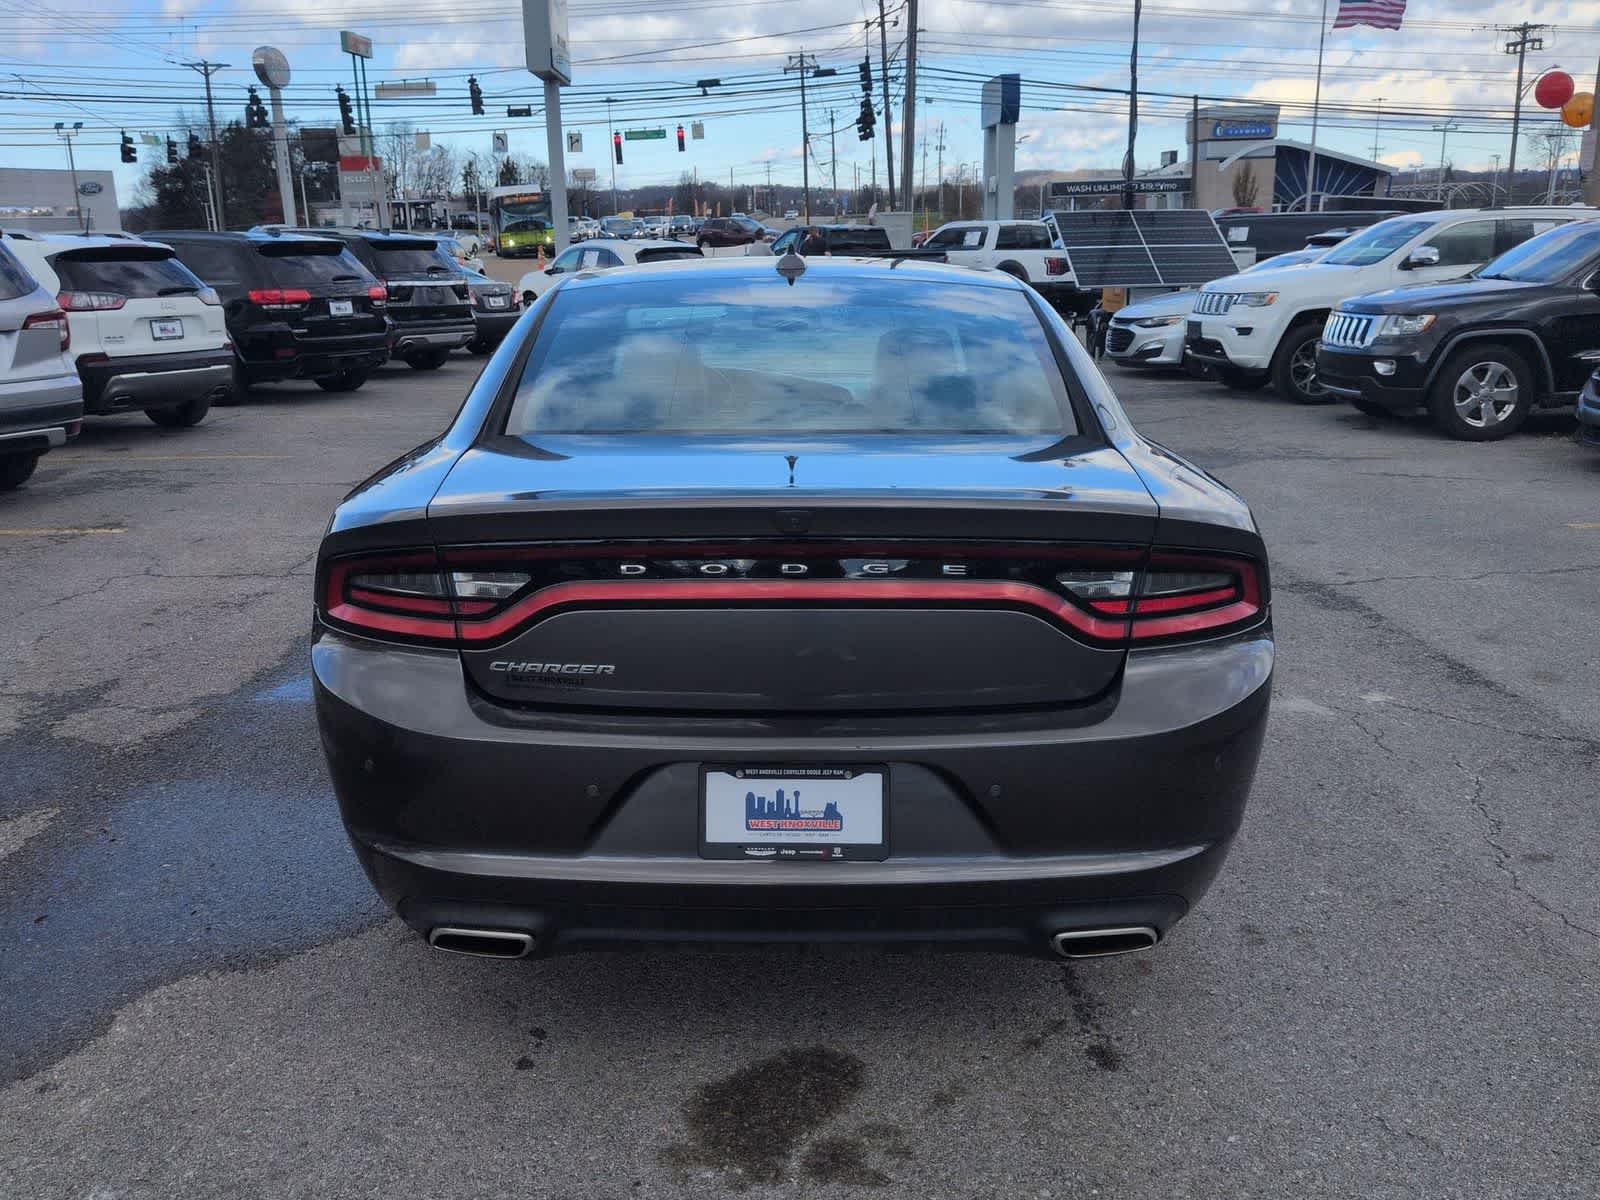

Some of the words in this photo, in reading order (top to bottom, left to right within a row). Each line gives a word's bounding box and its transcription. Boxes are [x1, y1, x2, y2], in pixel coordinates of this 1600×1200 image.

[343, 175, 377, 183] ISUZ
[1067, 183, 1092, 193] WASH
[620, 564, 967, 575] DODGE
[489, 661, 616, 675] CHARGER
[749, 819, 779, 830] WEST
[780, 819, 840, 830] KNOXVILLE
[780, 848, 796, 856] Jeep
